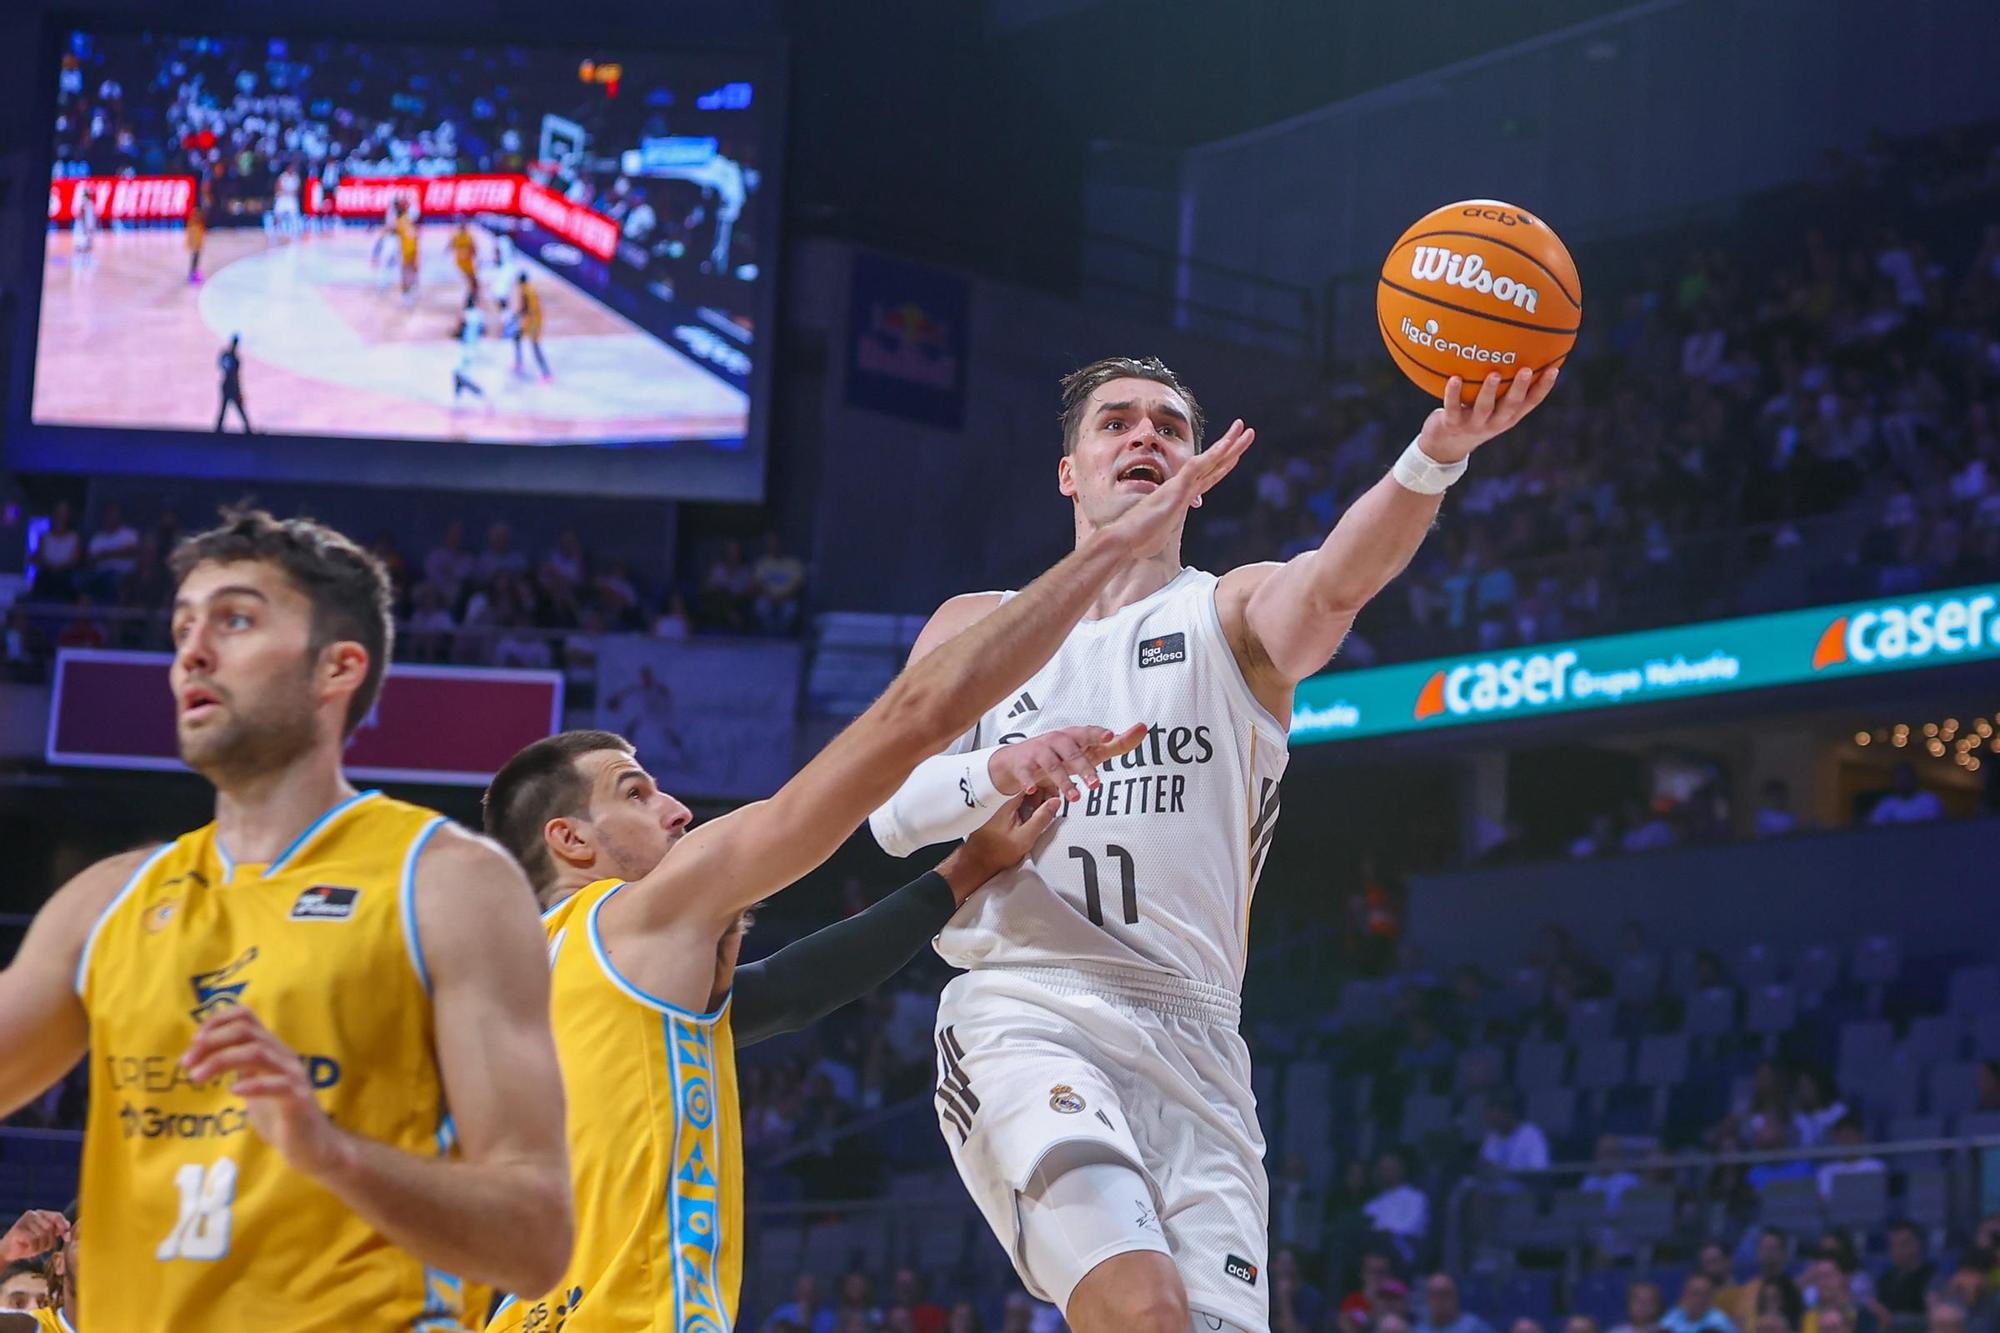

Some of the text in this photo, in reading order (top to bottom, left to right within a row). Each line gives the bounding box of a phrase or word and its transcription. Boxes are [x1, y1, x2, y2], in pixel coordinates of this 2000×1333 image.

[1462, 207, 1517, 226] acb
[1410, 246, 1538, 314] Wilson
[1400, 317, 1517, 365] liga endesa
[1142, 647, 1161, 658] liga
[1847, 596, 1995, 664] caser
[1142, 651, 1183, 665] endesa
[1447, 651, 1577, 714] caser
[1085, 775, 1185, 817] BETTER
[1068, 844, 1139, 926] 11
[156, 1157, 238, 1262] 18
[1227, 1263, 1251, 1281] acb
